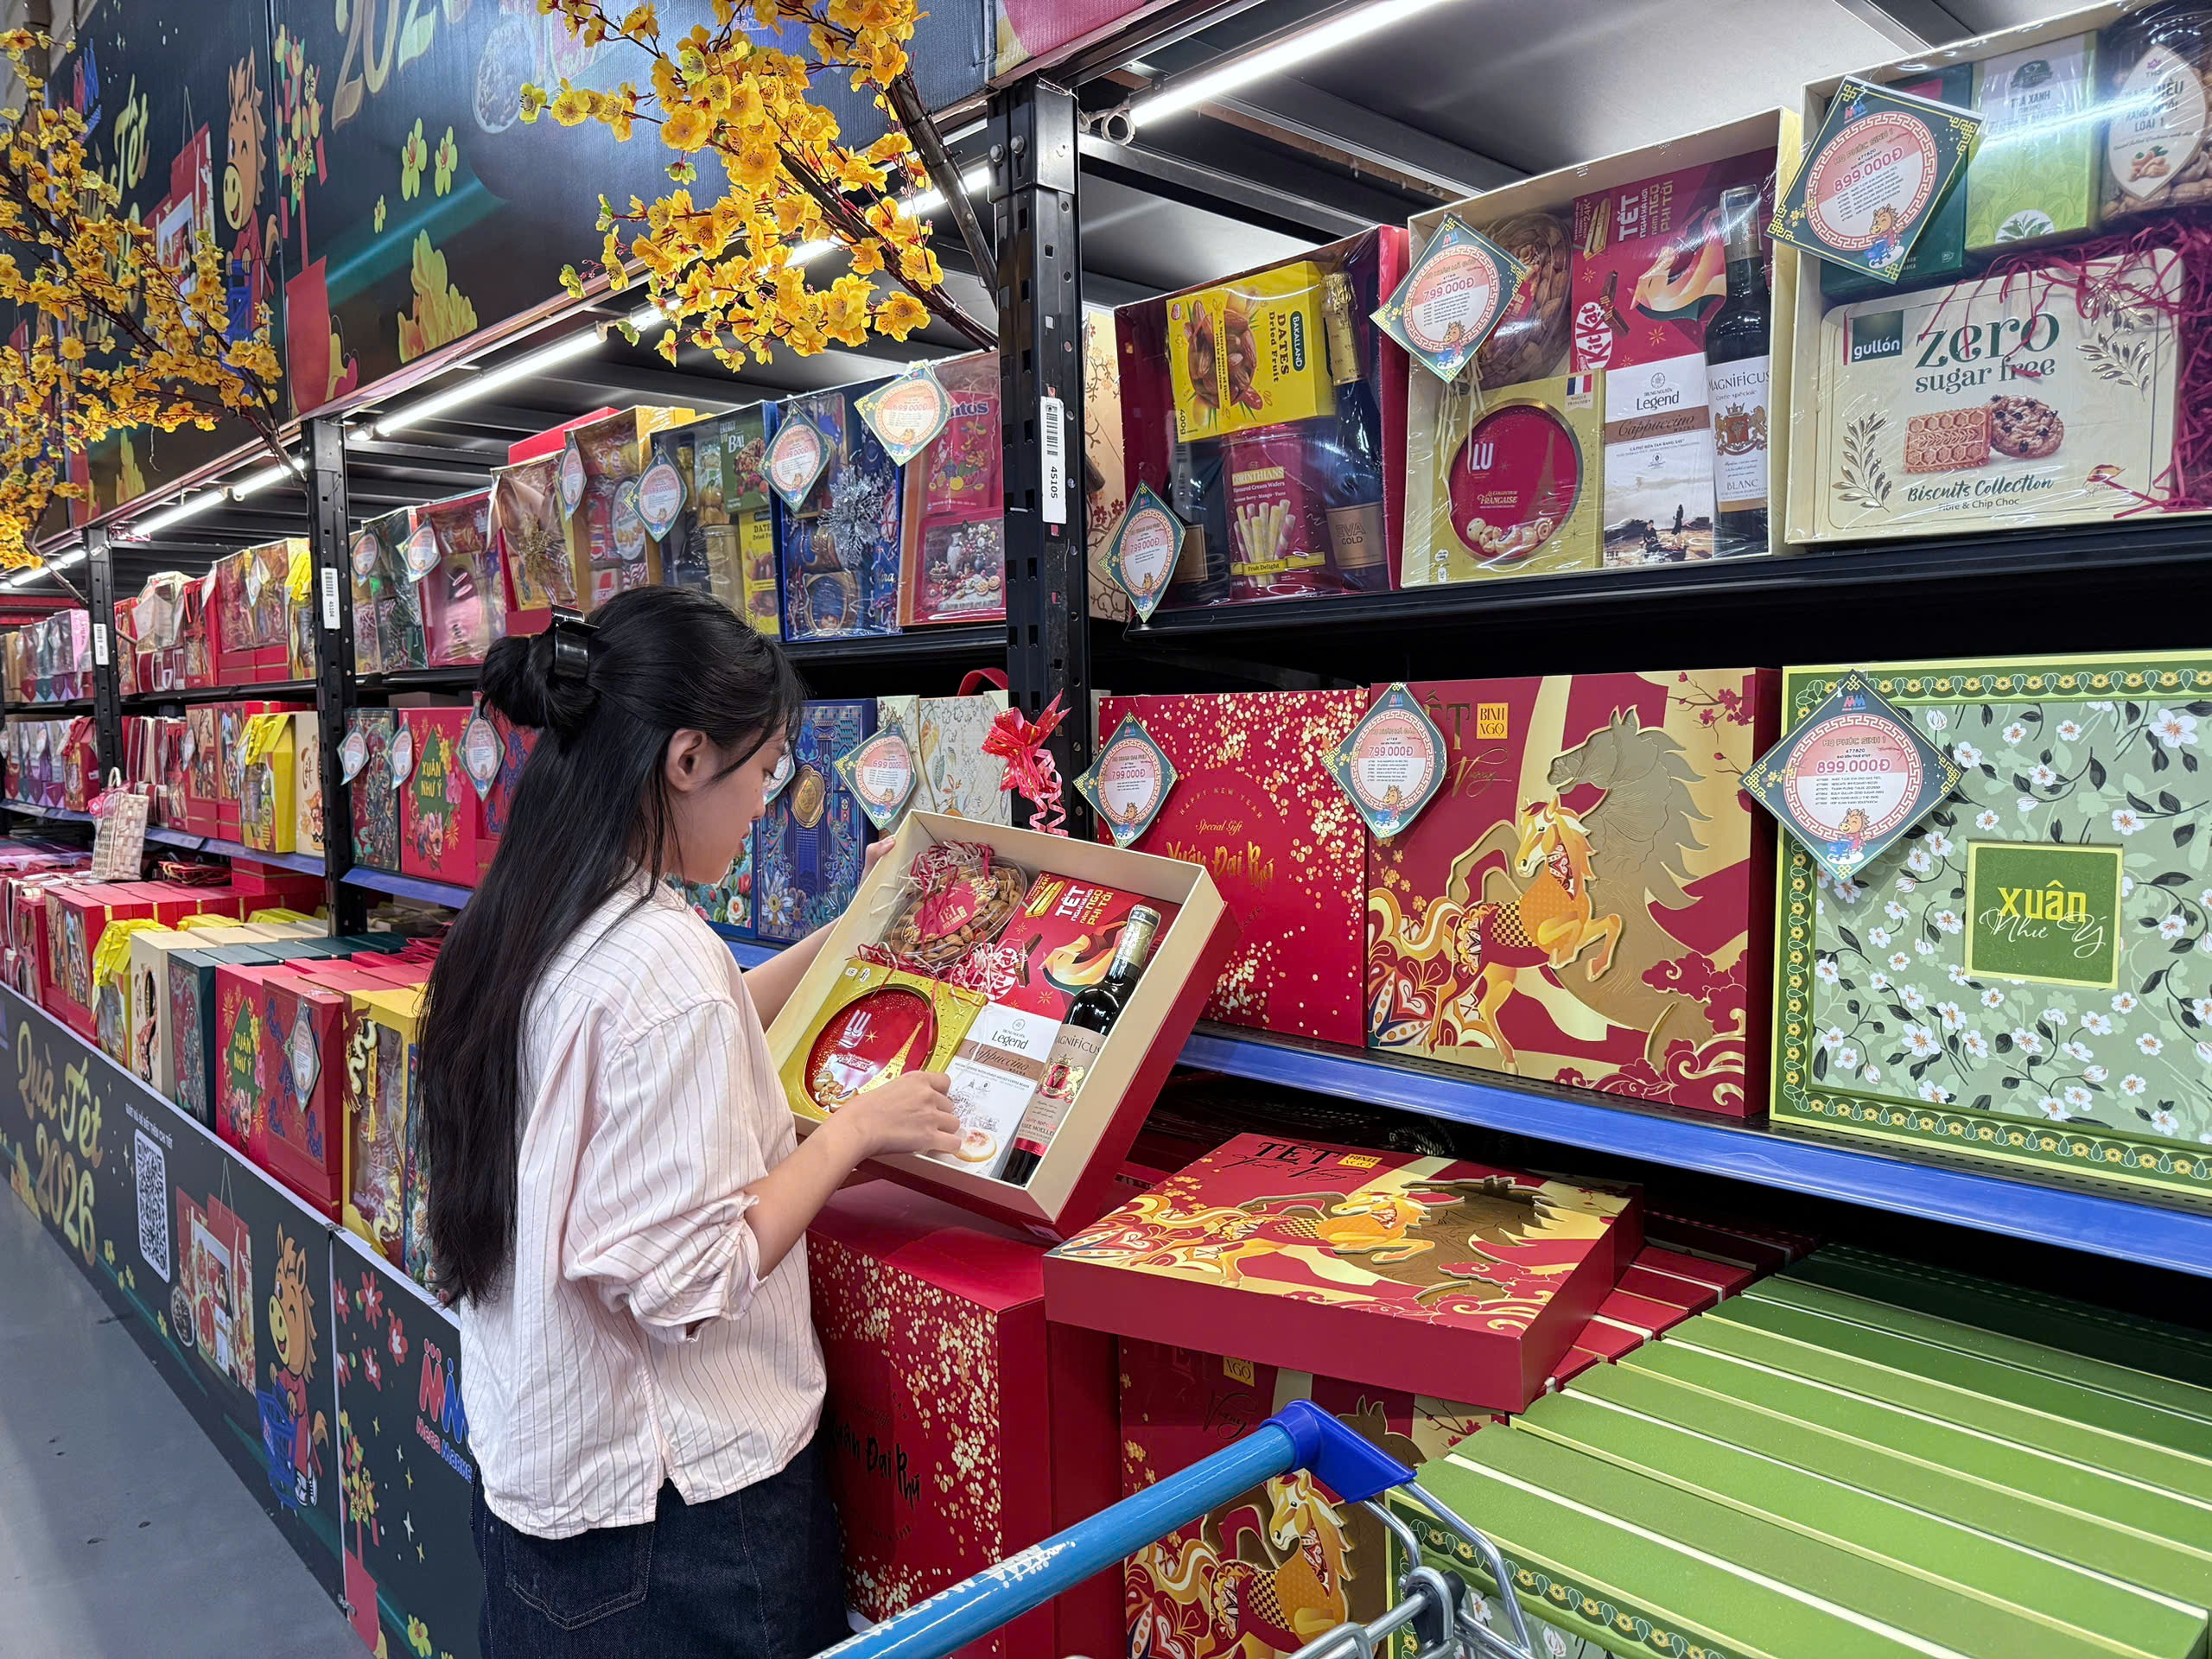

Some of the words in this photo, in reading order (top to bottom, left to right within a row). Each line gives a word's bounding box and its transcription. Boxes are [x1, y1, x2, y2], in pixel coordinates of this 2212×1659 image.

[2028, 91, 2050, 104] XANH
[1834, 147, 1904, 193] 899.000Đ
[1618, 194, 1639, 242] TẾT
[1423, 277, 1474, 301] 799.000Đ
[1268, 311, 1277, 346] Dried
[1292, 315, 1303, 367] BAKALLAND
[1576, 304, 1611, 365] KitKat
[1915, 312, 2060, 369] zero
[1277, 313, 1289, 375] DATES
[1854, 337, 1901, 359] gullón
[1915, 367, 1992, 394] sugar
[1999, 356, 2056, 382] free
[1637, 391, 1680, 410] Legend
[1618, 415, 1694, 440] Cappuccino
[1472, 442, 1494, 470] LU
[1050, 466, 1058, 499] 45105
[1727, 479, 1758, 491] BLANC
[1907, 480, 1970, 502] Biscuits
[1974, 474, 2054, 496] Collection
[1972, 499, 1993, 512] Chip
[1995, 497, 2020, 507] Choc
[753, 523, 770, 533] DATE
[1335, 521, 1365, 537] EVA
[1341, 536, 1363, 545] GOLD
[1369, 746, 1414, 757] 799.000Đ
[1861, 736, 1880, 745] SINH
[422, 757, 441, 778] XUÂN
[1112, 769, 1145, 779] 799.000Đ
[1817, 759, 1891, 774] 899.000Đ
[1196, 818, 1225, 835] Special
[1226, 820, 1243, 836] Gift
[1055, 886, 1085, 918] TẾT
[1979, 906, 2048, 942] Như
[843, 1009, 872, 1037] LU
[992, 1030, 1028, 1050] Legend
[969, 1044, 1030, 1071] Cappuccino
[60, 1057, 103, 1168] Tết
[35, 1122, 96, 1265] 2026
